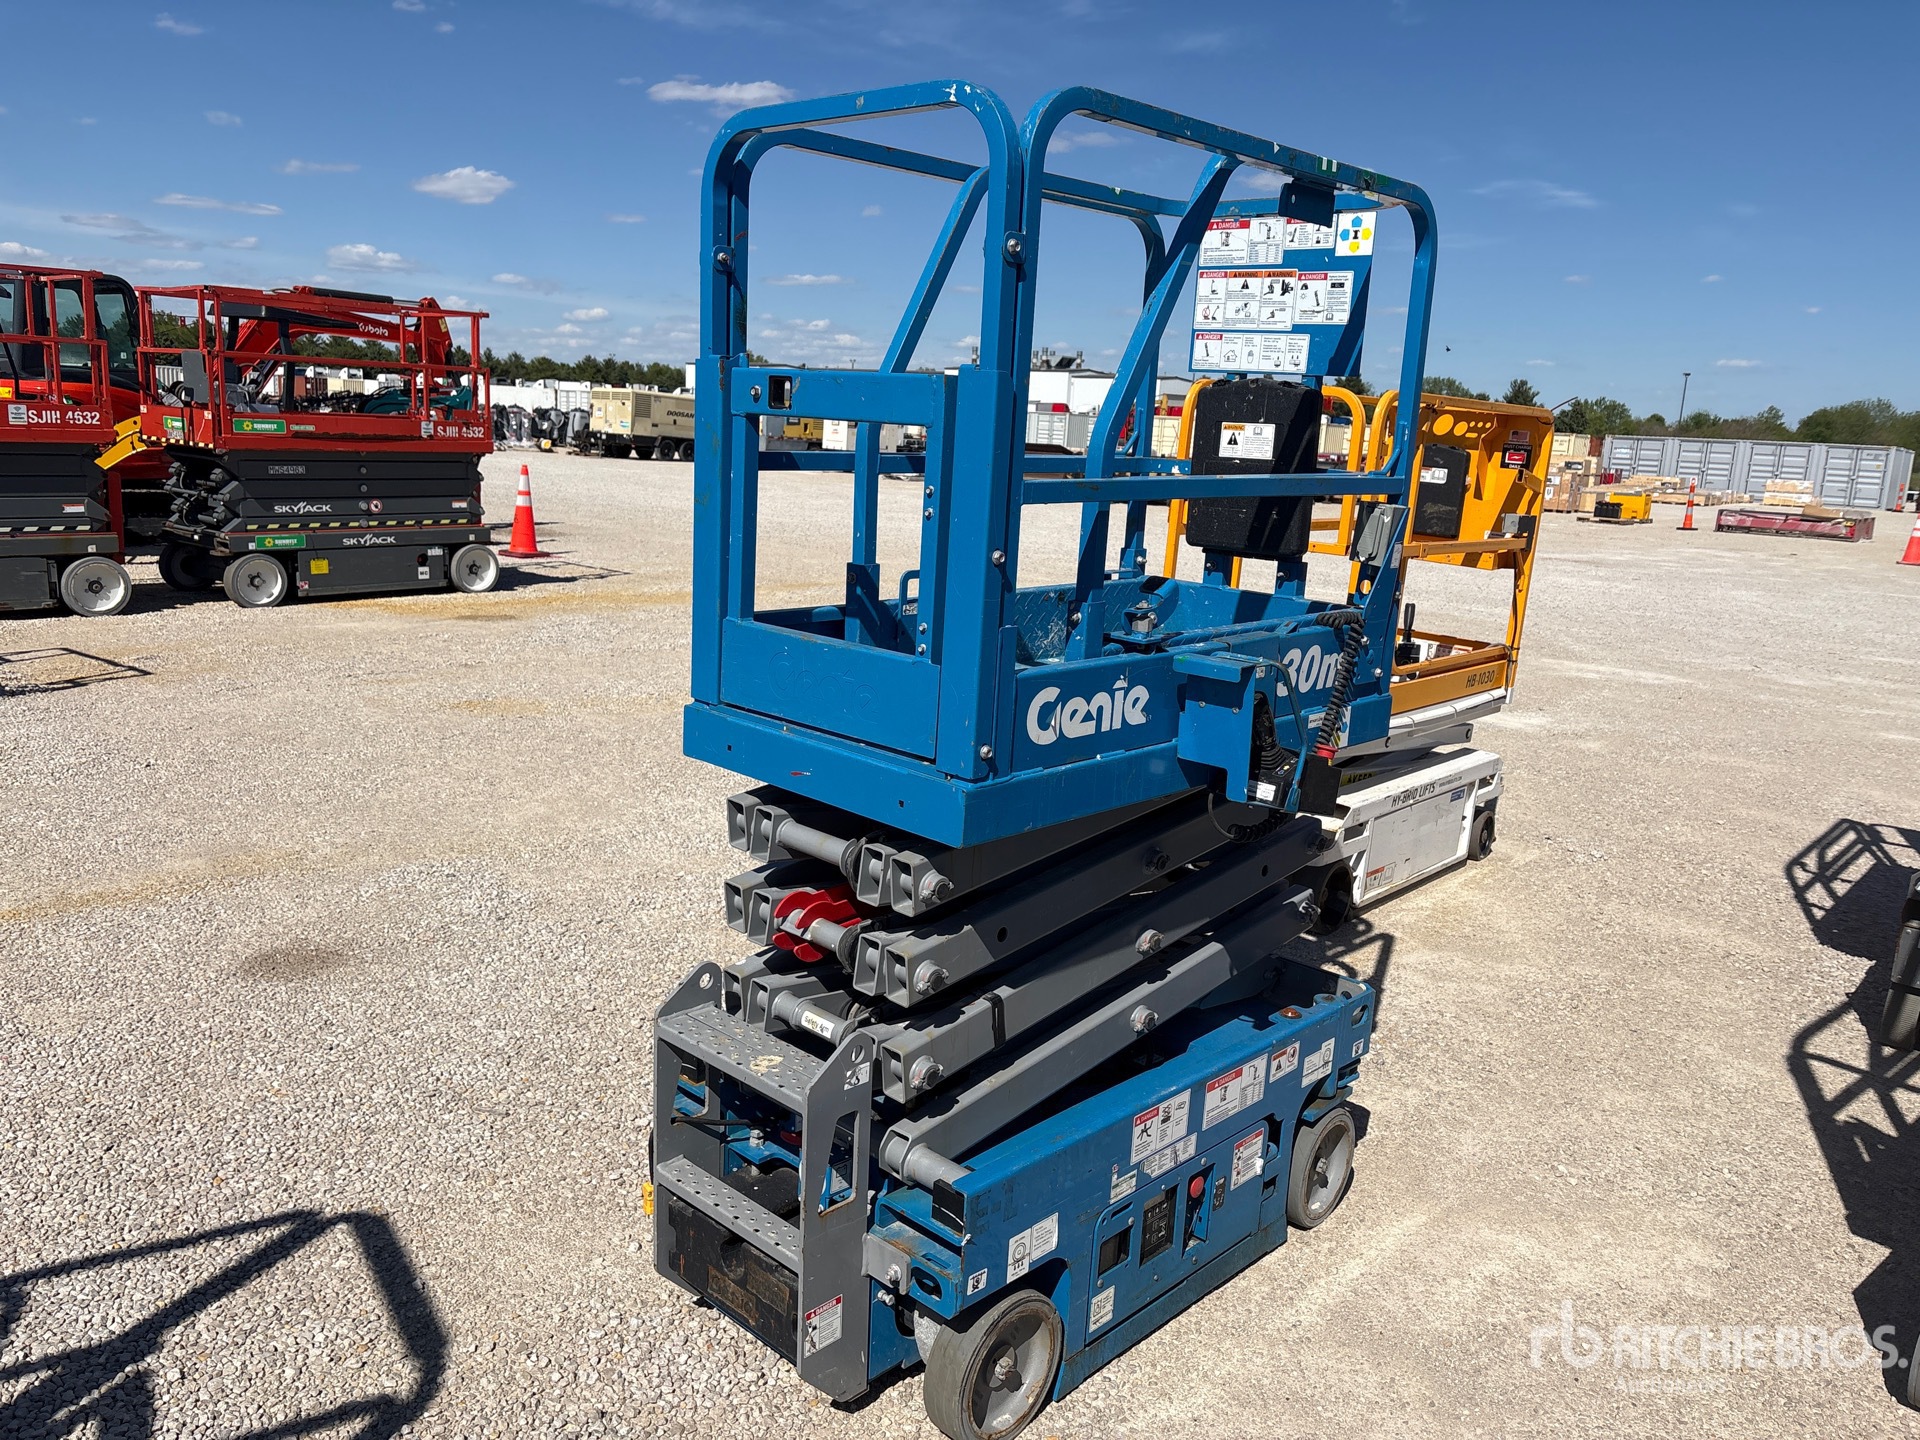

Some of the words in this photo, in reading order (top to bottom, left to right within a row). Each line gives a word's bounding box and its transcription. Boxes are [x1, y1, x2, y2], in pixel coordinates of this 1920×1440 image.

[1218, 221, 1240, 229] DANGER
[356, 321, 389, 337] Kubota
[65, 410, 101, 425] 4632
[666, 409, 695, 419] DOOSAN
[461, 426, 485, 438] 4632
[273, 501, 332, 515] SKYJACK
[342, 533, 397, 547] SKYJACK
[1026, 677, 1150, 746] Genie
[1418, 781, 1437, 798] LIFTS
[804, 1015, 819, 1031] Safety
[1219, 1072, 1236, 1088] DANGER
[1140, 1108, 1159, 1122] DANGER
[815, 1299, 837, 1316] DANGER
